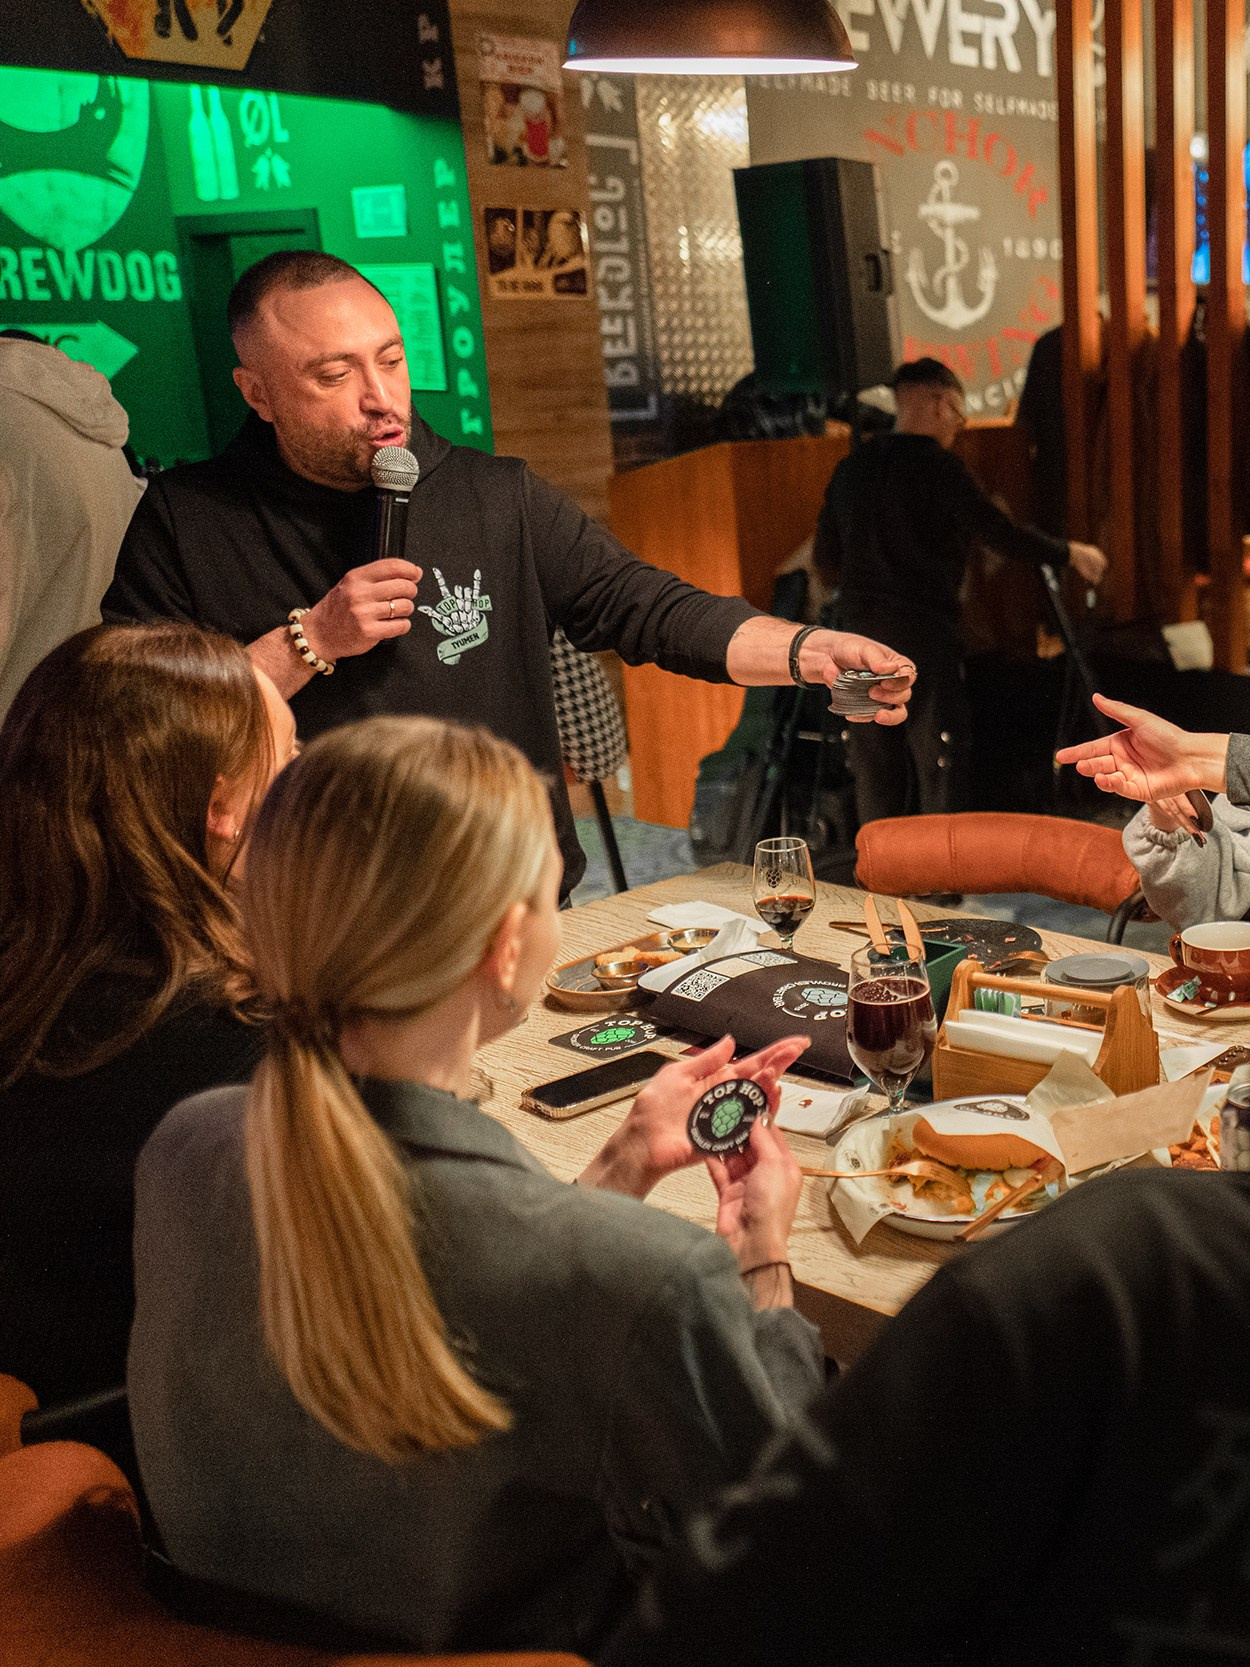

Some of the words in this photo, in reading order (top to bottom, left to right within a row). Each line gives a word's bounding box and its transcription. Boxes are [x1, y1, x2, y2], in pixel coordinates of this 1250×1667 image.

[928, 86, 963, 109] FOR
[439, 599, 456, 614] TOP
[472, 599, 489, 608] HOP
[451, 632, 480, 649] TYUMEN
[814, 1009, 848, 1020] OP
[703, 1082, 737, 1105] TOP
[739, 1081, 765, 1107] HOP
